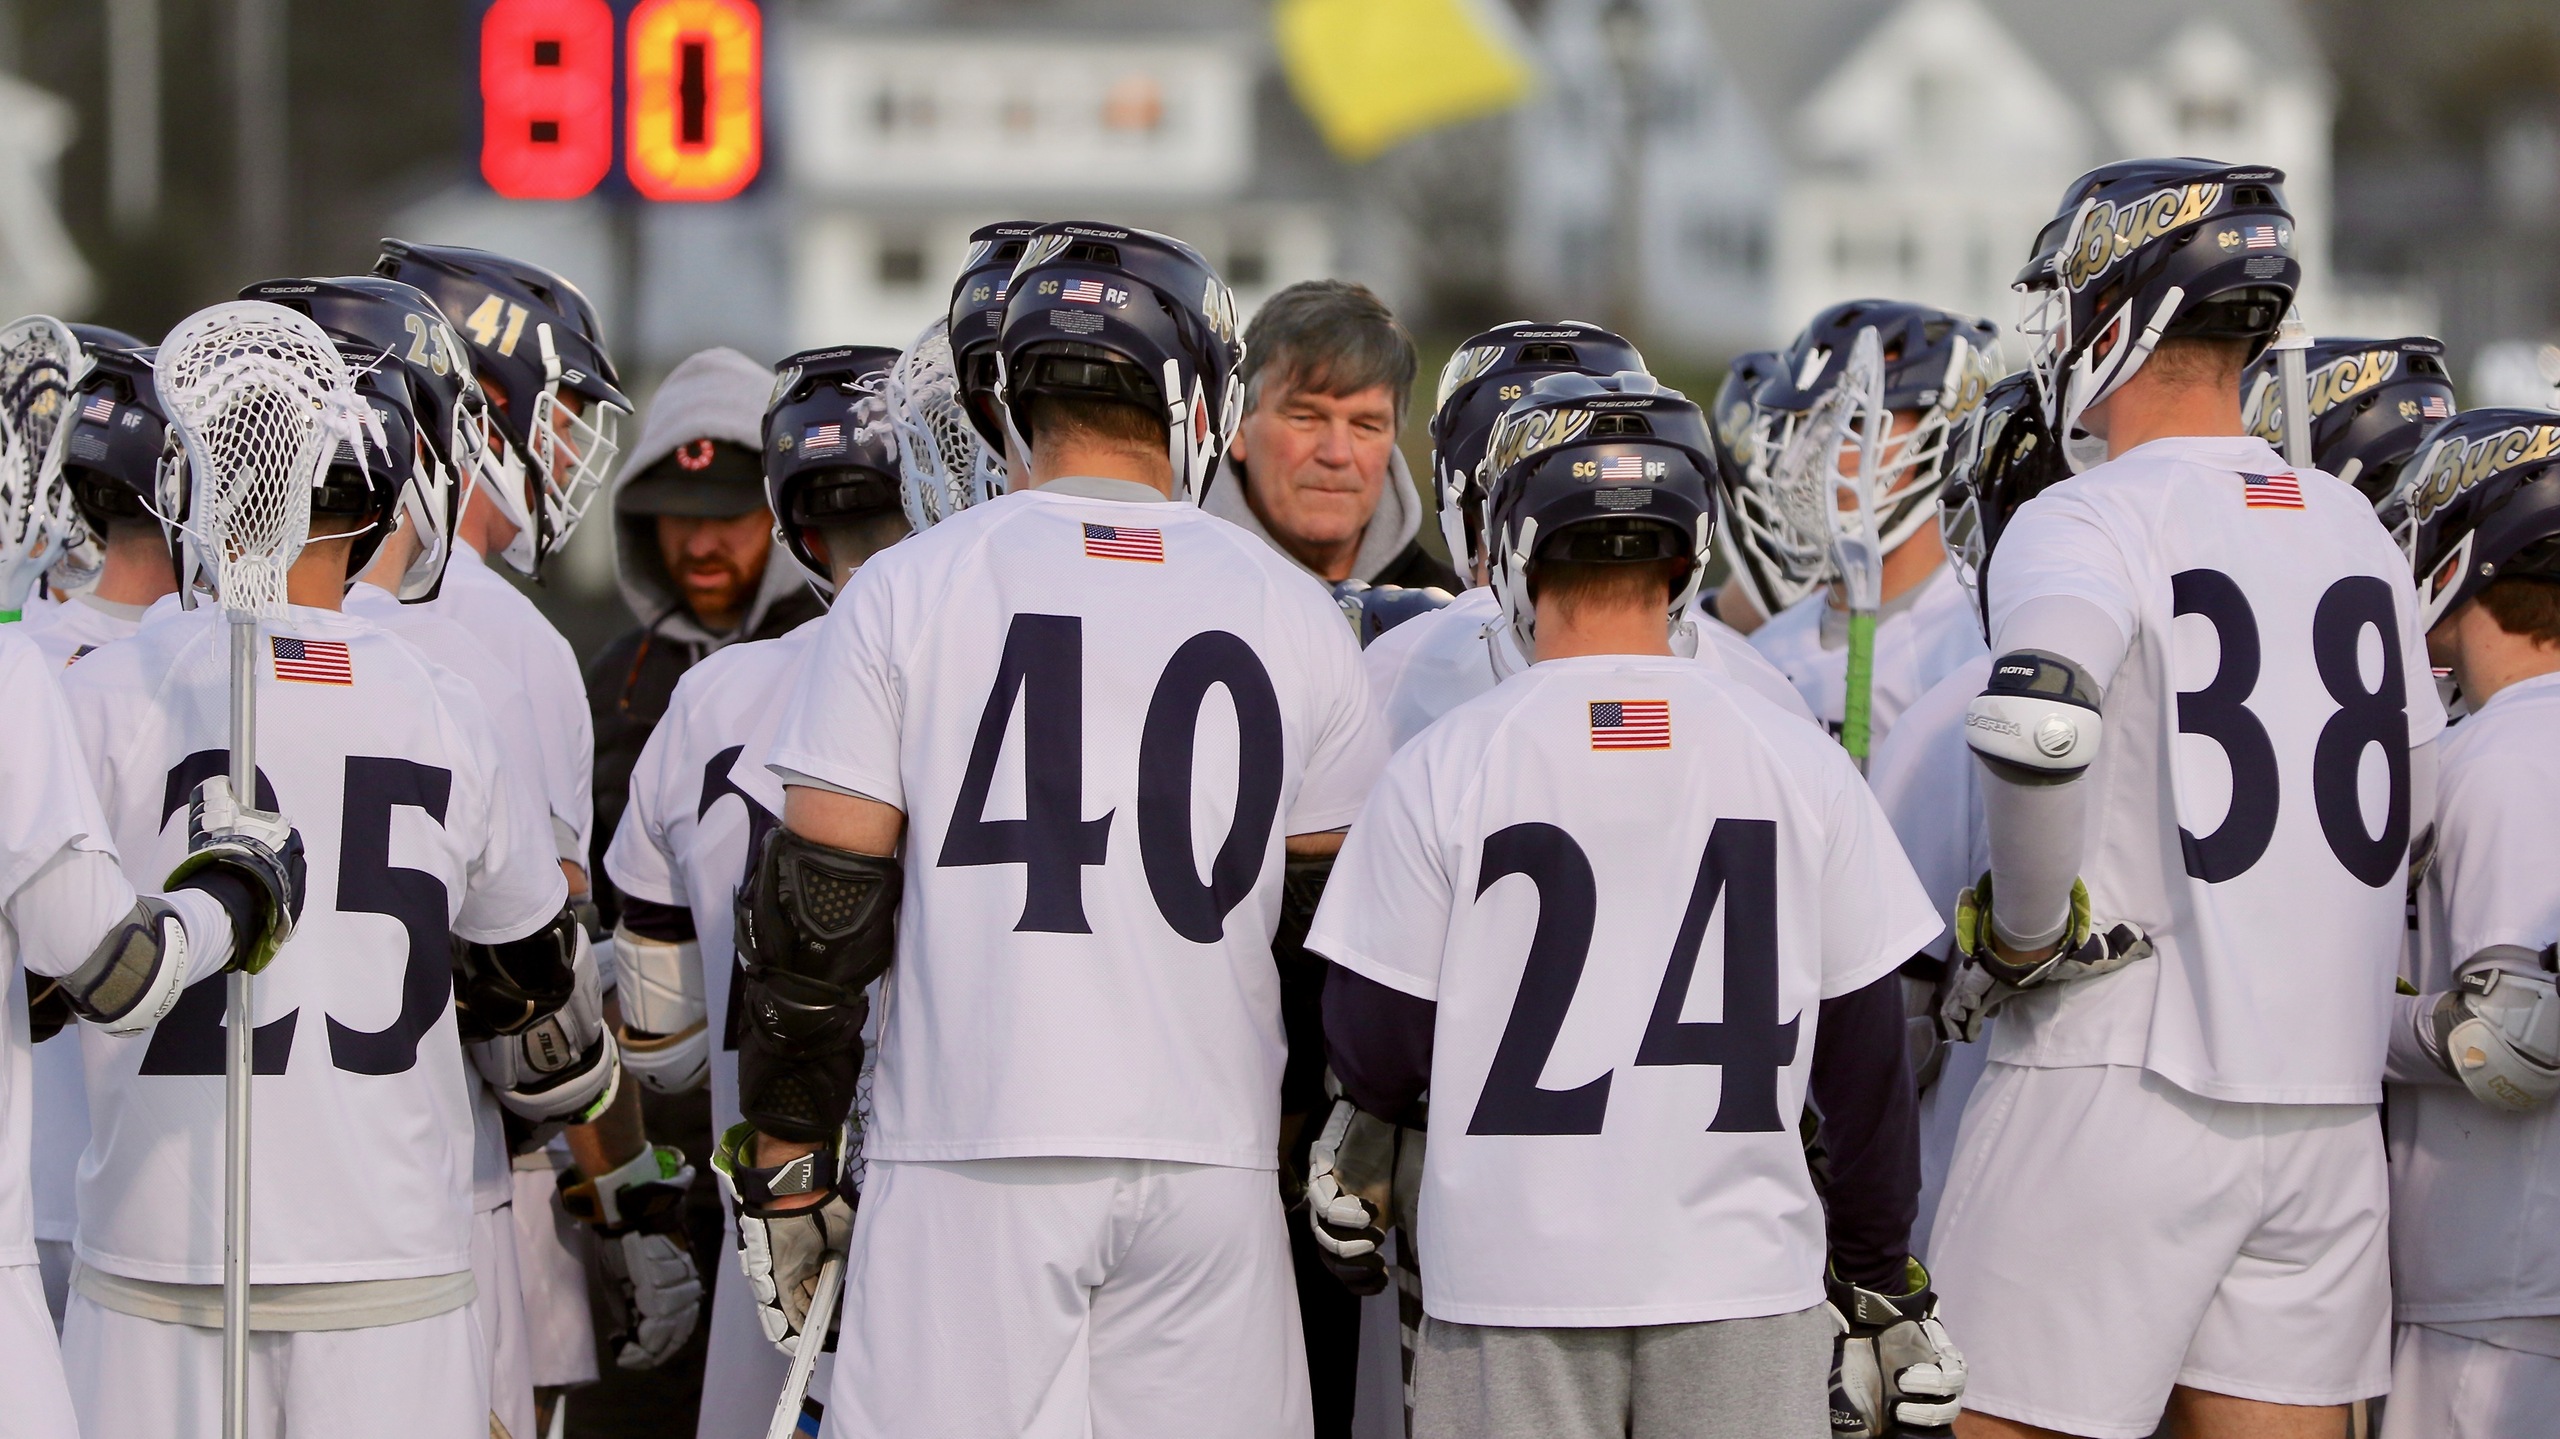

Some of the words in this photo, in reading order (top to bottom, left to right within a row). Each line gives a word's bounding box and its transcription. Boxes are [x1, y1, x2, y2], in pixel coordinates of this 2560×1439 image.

[1064, 226, 1129, 240] cascade
[2069, 183, 2224, 293] Bucs
[2217, 230, 2239, 248] SC
[260, 285, 317, 294] cascade
[972, 286, 990, 302] SC
[1038, 280, 1059, 296] SC
[1105, 288, 1129, 304] RF
[466, 292, 529, 358] 41
[1513, 329, 1581, 339] cascade
[404, 313, 449, 377] 23
[796, 350, 852, 363] cascade
[1500, 384, 1522, 401] SC
[1586, 399, 1655, 408] cascade
[2399, 401, 2419, 417] SC
[120, 411, 144, 428] RF
[778, 435, 794, 453] SC
[1572, 461, 1597, 478] SC
[1645, 461, 1666, 476] RF
[2172, 568, 2412, 889] 38
[937, 612, 1284, 944] 40
[1465, 818, 1804, 1136] 24
